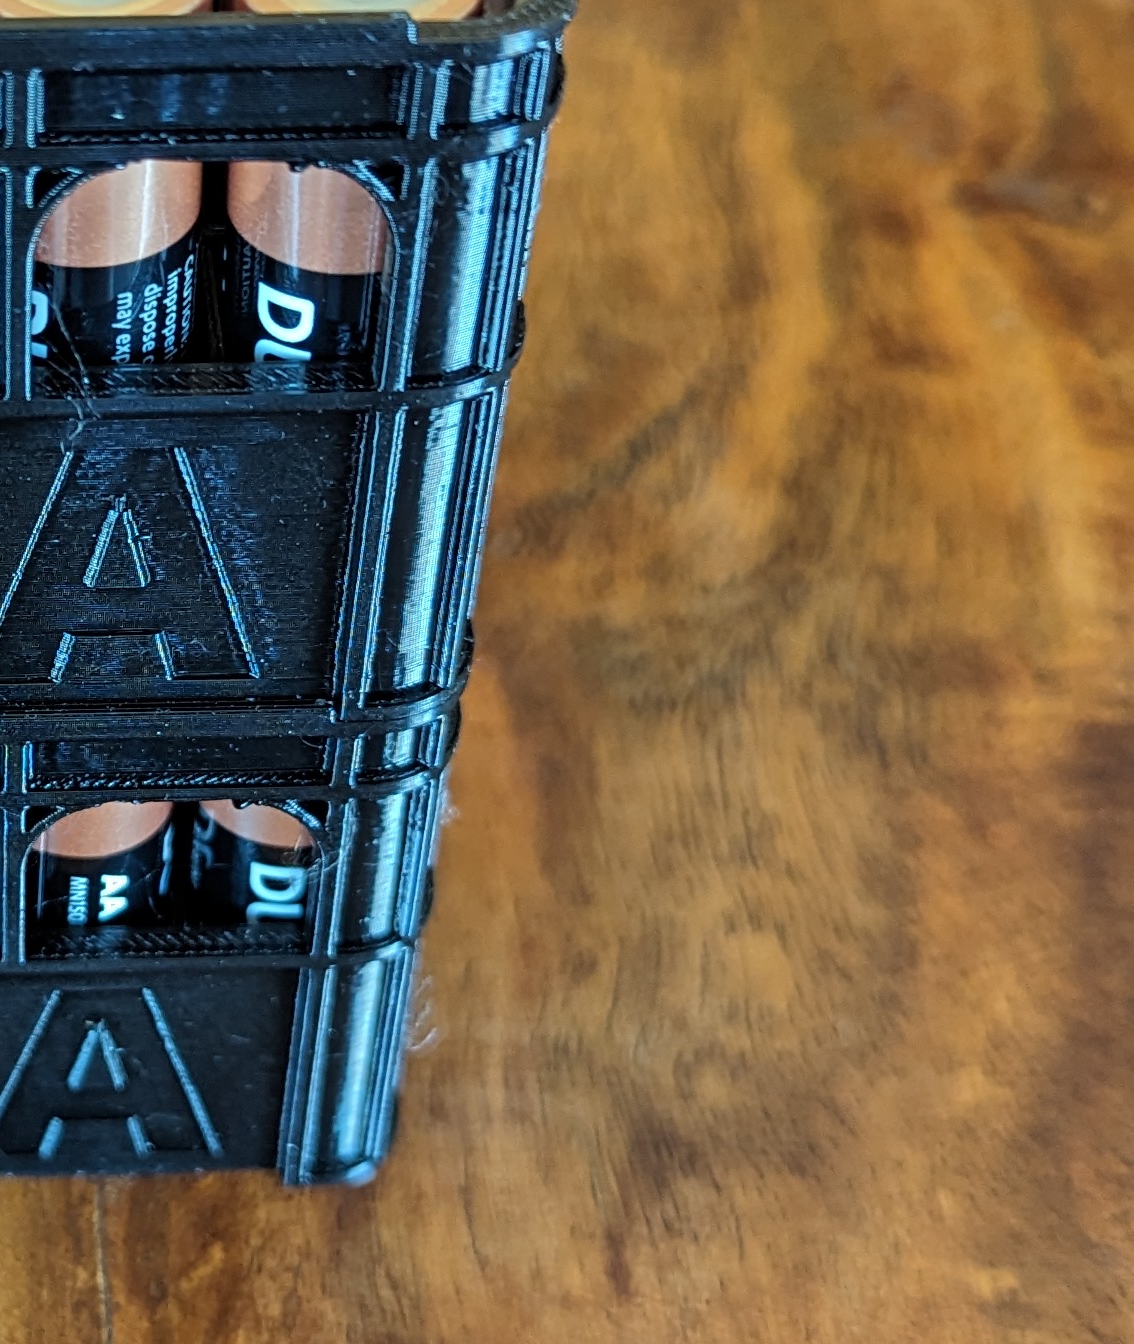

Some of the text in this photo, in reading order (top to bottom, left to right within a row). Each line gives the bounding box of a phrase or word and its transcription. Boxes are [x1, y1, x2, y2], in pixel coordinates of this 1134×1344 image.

[111, 291, 134, 330] may
[139, 282, 164, 354] dispose
[66, 875, 90, 927] MN150
[97, 873, 131, 923] AA
